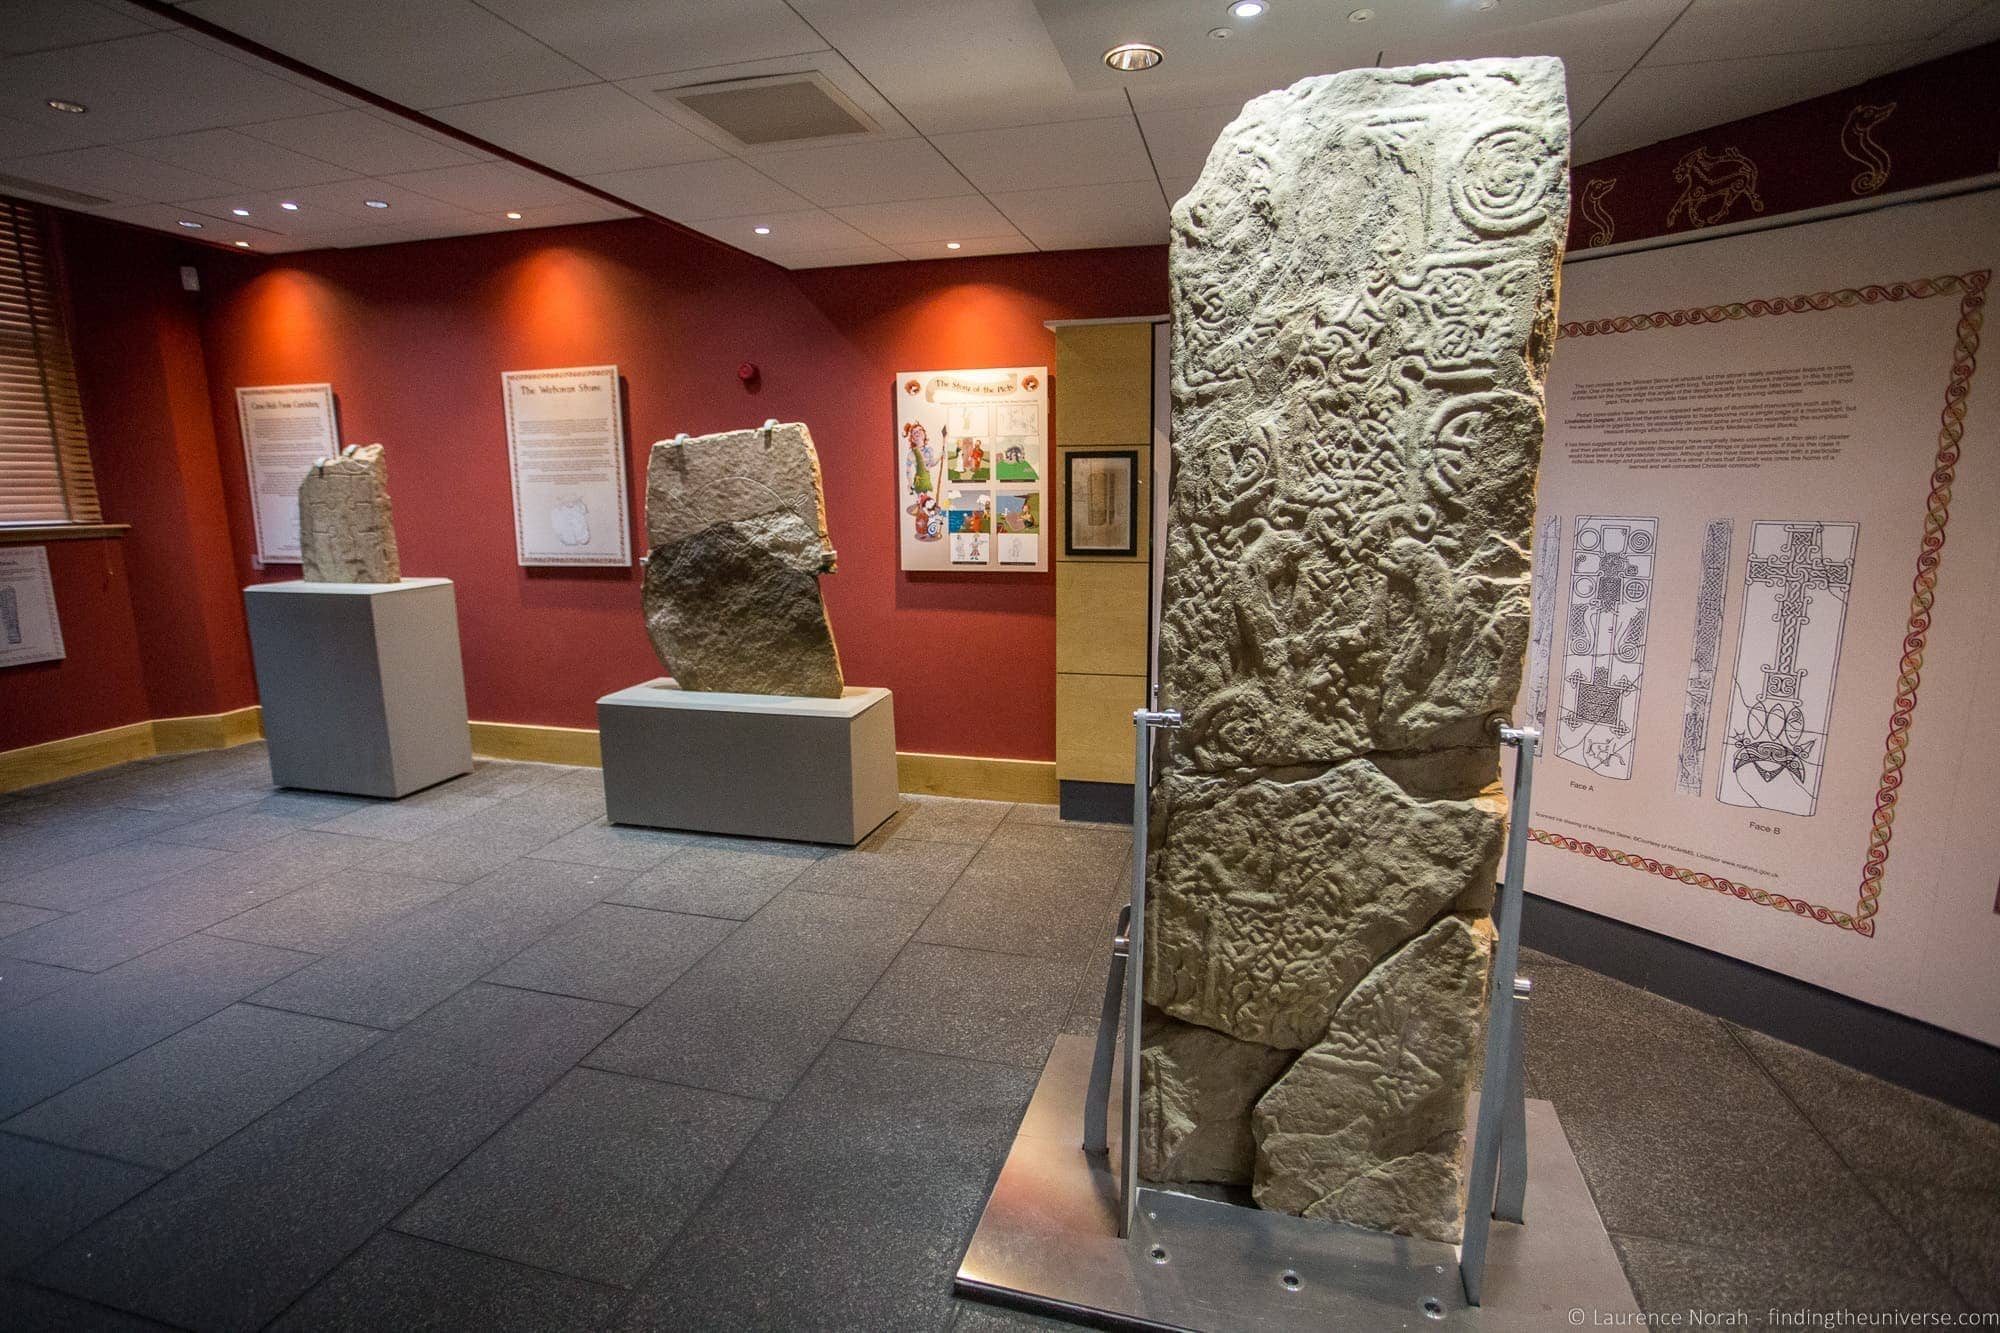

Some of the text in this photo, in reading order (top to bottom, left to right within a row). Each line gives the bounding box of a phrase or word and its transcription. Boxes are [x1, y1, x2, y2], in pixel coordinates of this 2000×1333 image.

[936, 380, 948, 388] The
[520, 385, 534, 395] The
[1570, 780, 1588, 791] Face
[1750, 822, 1781, 836] Face B
